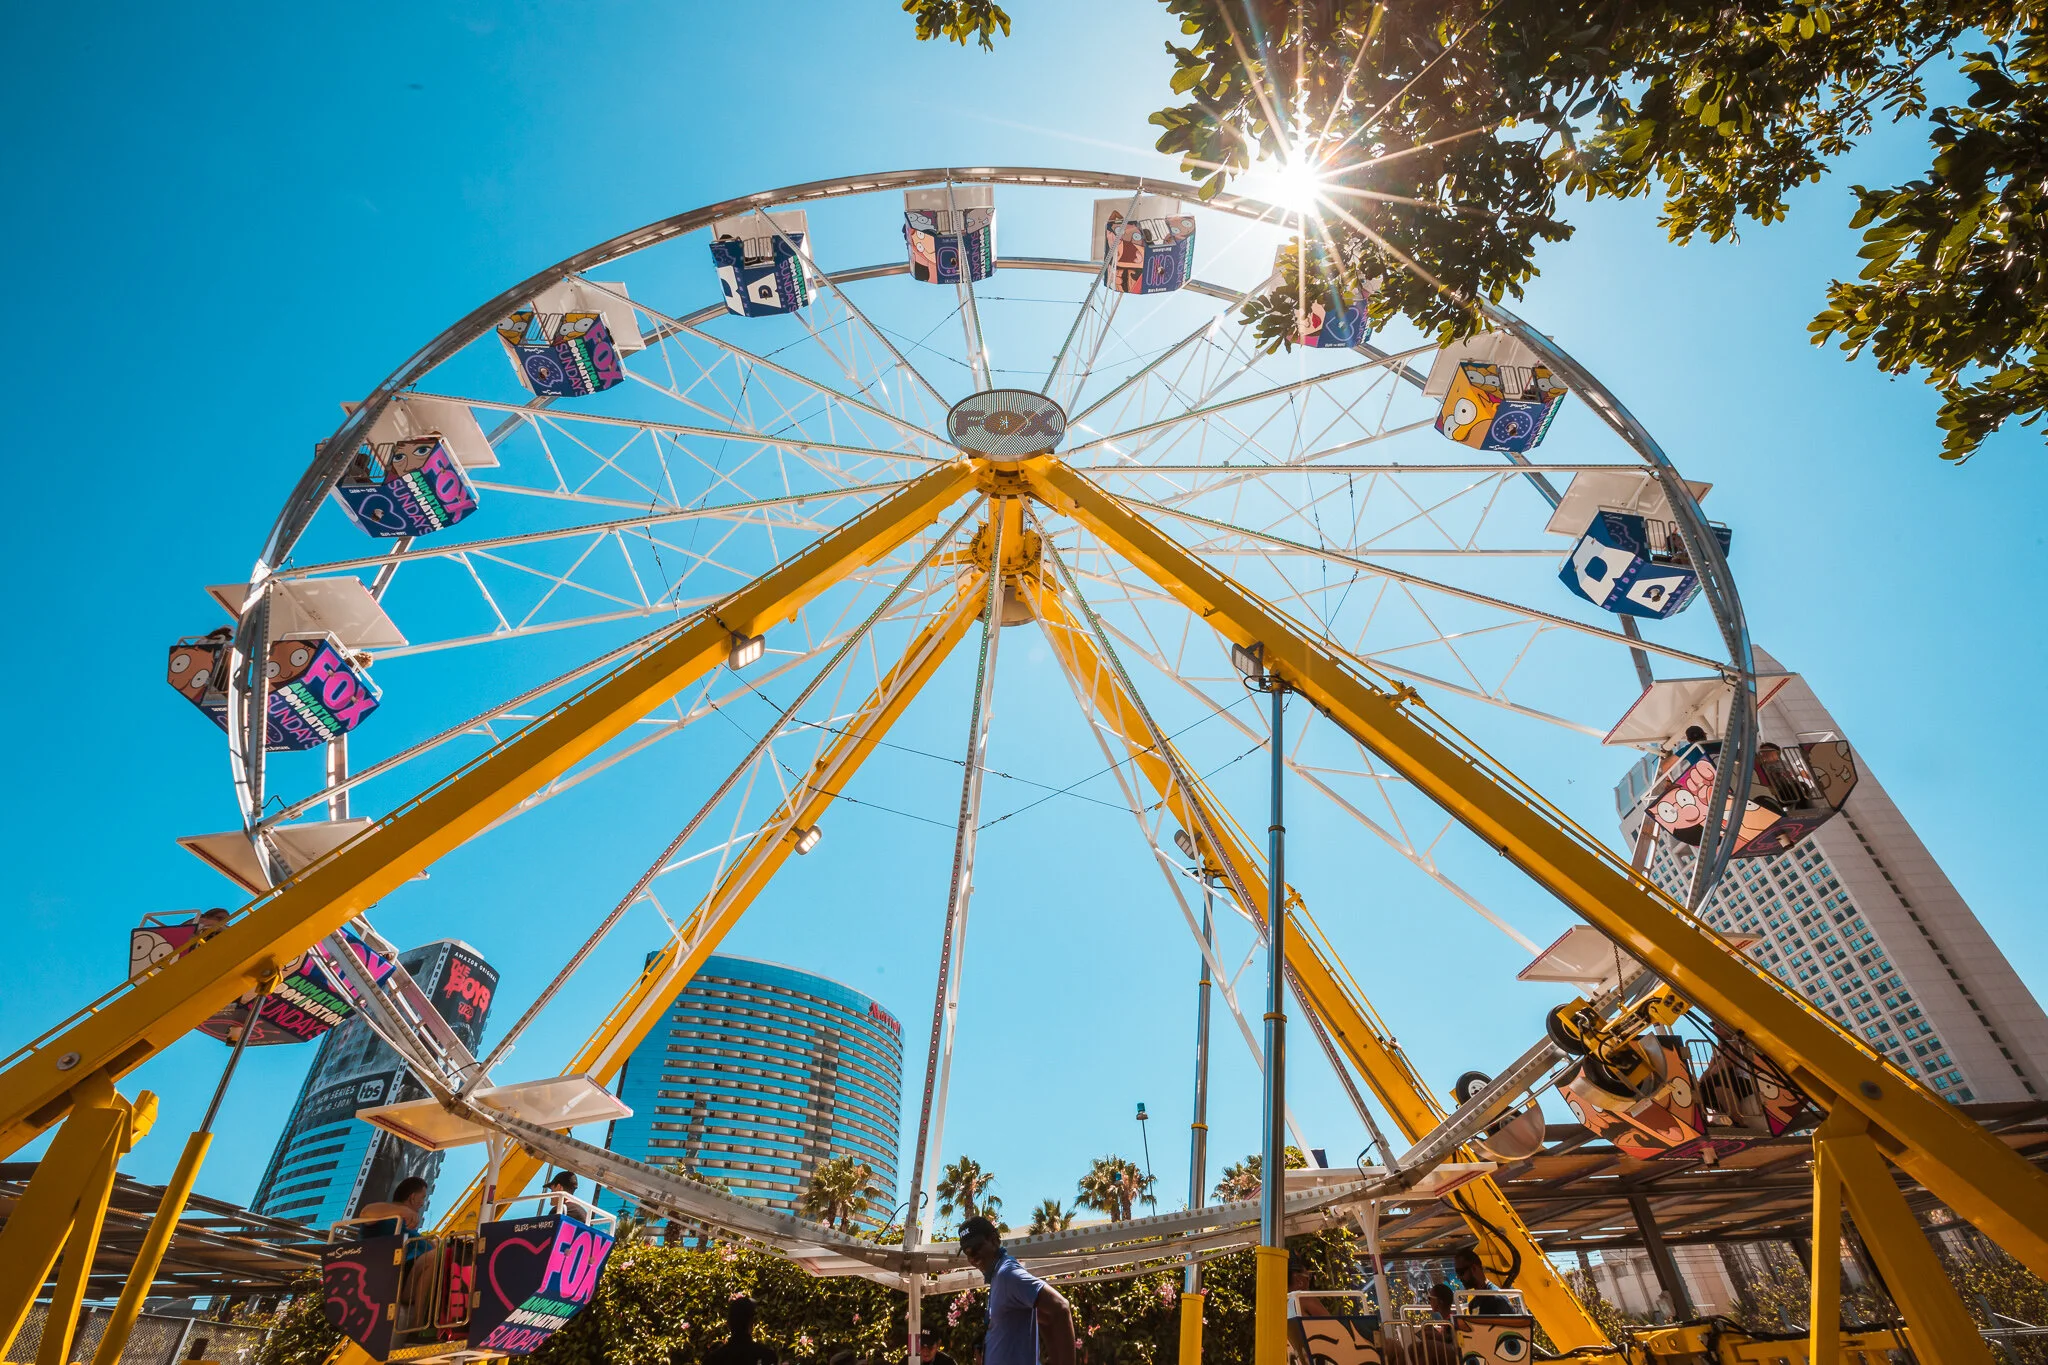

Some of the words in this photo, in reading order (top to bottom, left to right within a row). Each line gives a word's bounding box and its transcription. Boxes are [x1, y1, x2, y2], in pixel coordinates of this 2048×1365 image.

[780, 260, 797, 312] SUNDAYS
[556, 343, 587, 396] SUNDAYS
[567, 339, 596, 394] DOMINATION
[575, 338, 600, 387] ANIMATION
[584, 321, 621, 389] FOX
[955, 410, 1058, 437] FOX
[388, 479, 433, 536] SUNDAYS
[402, 473, 444, 531] DOMINATION
[410, 471, 448, 524] ANIMATION
[421, 448, 474, 524] FOX
[277, 685, 337, 741] DOMINATION
[288, 682, 341, 732] ANIMATION
[302, 647, 377, 730] FOX
[267, 693, 323, 749] SUNDAYS
[454, 952, 479, 967] AMAZON
[249, 995, 329, 1040] UNDAYS
[273, 984, 347, 1027] DOMINATION
[284, 975, 351, 1015] ANIMATION
[443, 975, 491, 1013] BOYS
[360, 1084, 382, 1099] tbs
[537, 1221, 613, 1304] FOX
[504, 1308, 570, 1330] DOMINATION
[518, 1295, 578, 1318] ANIMATION
[479, 1325, 552, 1352] SUNDAYS
